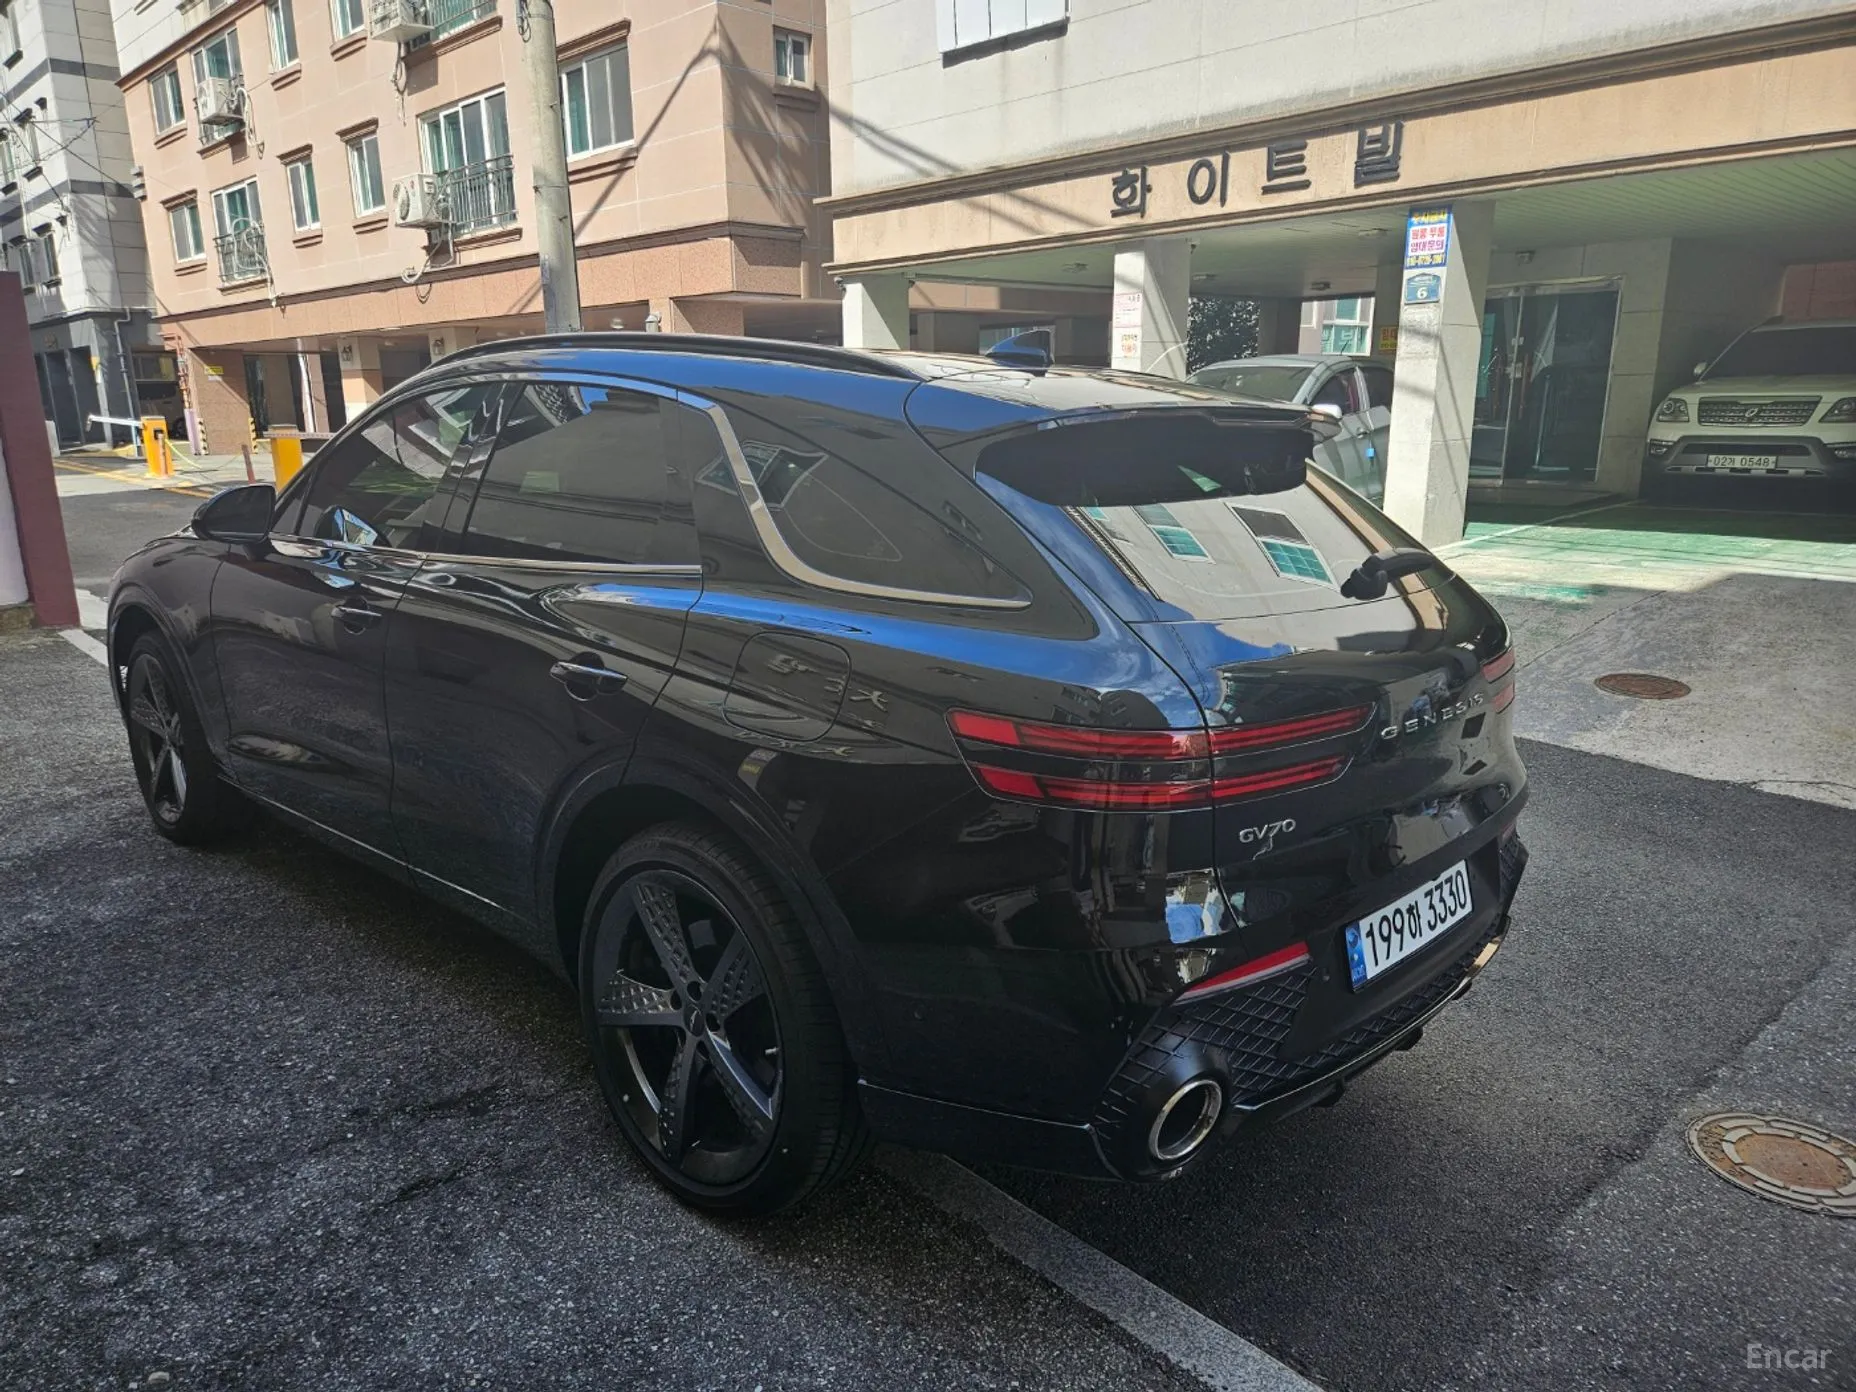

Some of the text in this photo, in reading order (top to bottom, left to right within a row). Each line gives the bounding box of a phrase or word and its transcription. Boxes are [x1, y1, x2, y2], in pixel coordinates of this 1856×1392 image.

[1110, 120, 1405, 219] 화이트빌
[1410, 240, 1444, 253] 임대문의
[1417, 286, 1428, 299] 6
[1381, 693, 1484, 739] GENESIS
[1239, 818, 1297, 843] GV70
[1366, 870, 1467, 967] 199하 3330
